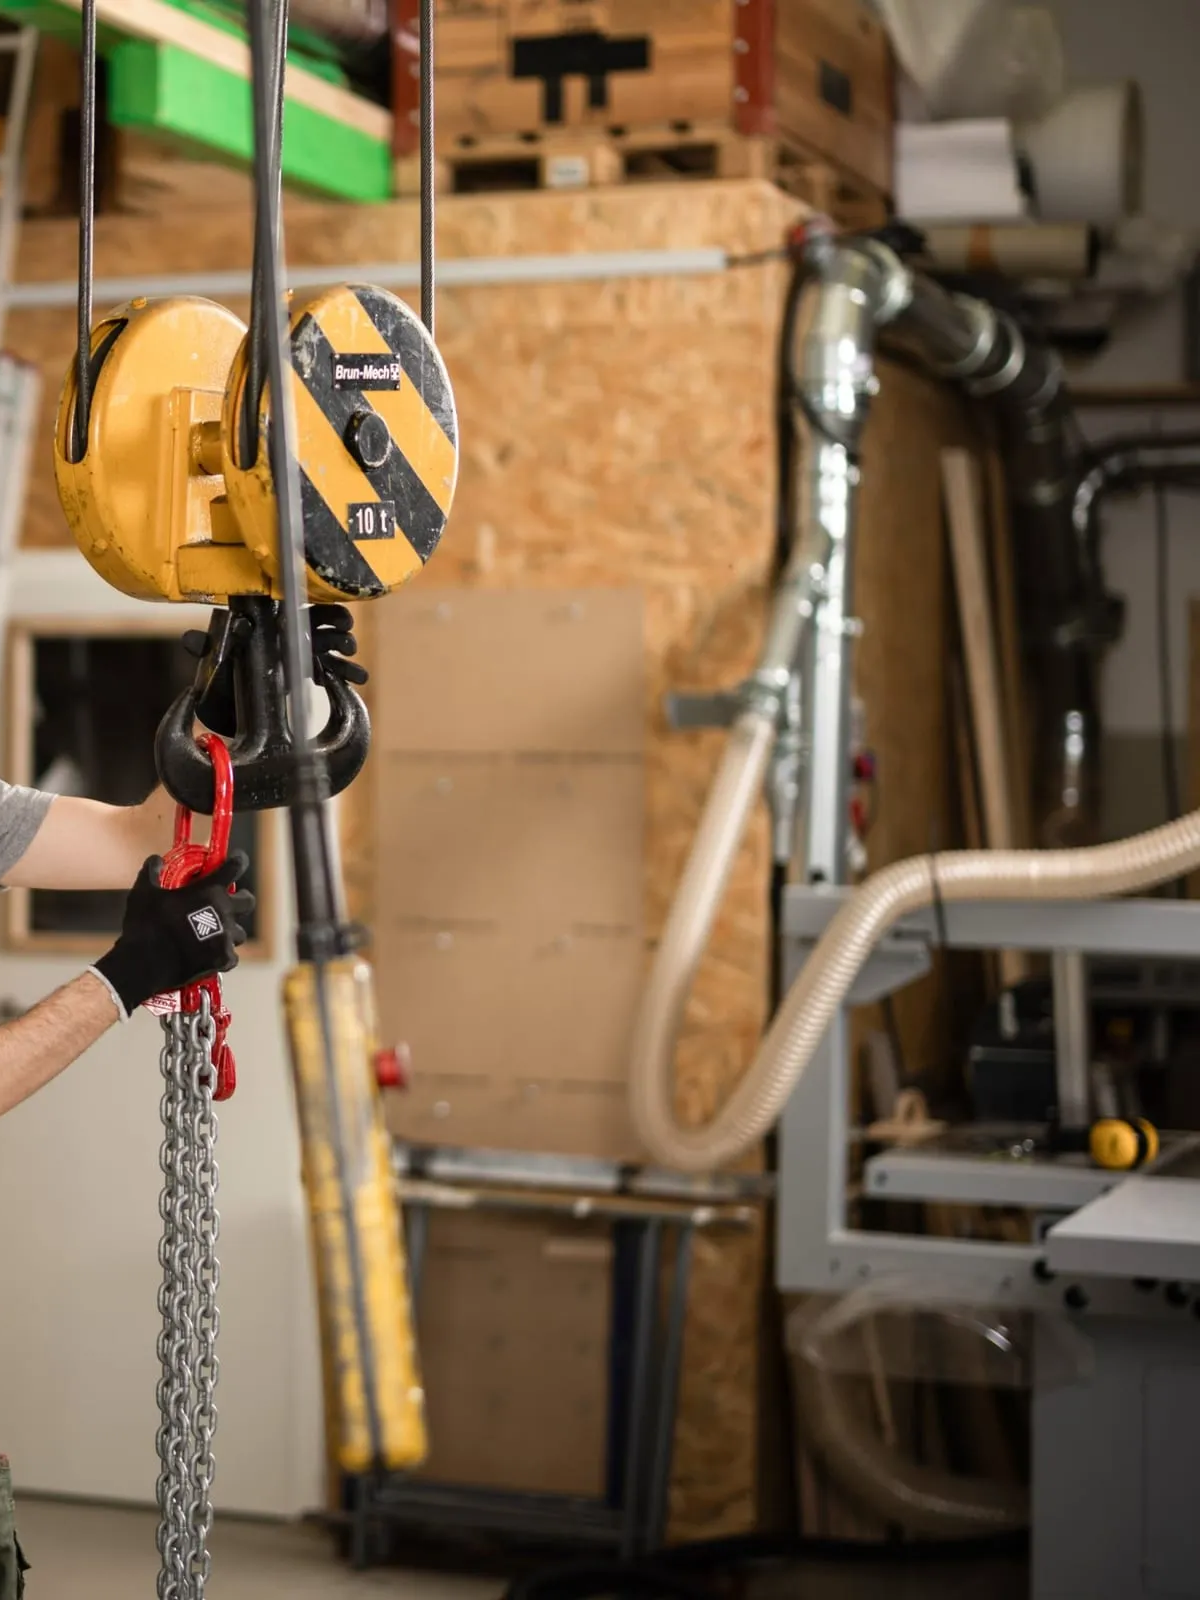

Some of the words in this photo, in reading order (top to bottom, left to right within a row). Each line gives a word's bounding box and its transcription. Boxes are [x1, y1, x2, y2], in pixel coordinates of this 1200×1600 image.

[335, 364, 389, 380] Brun-Mech
[355, 507, 374, 534] 10
[380, 509, 387, 533] t
